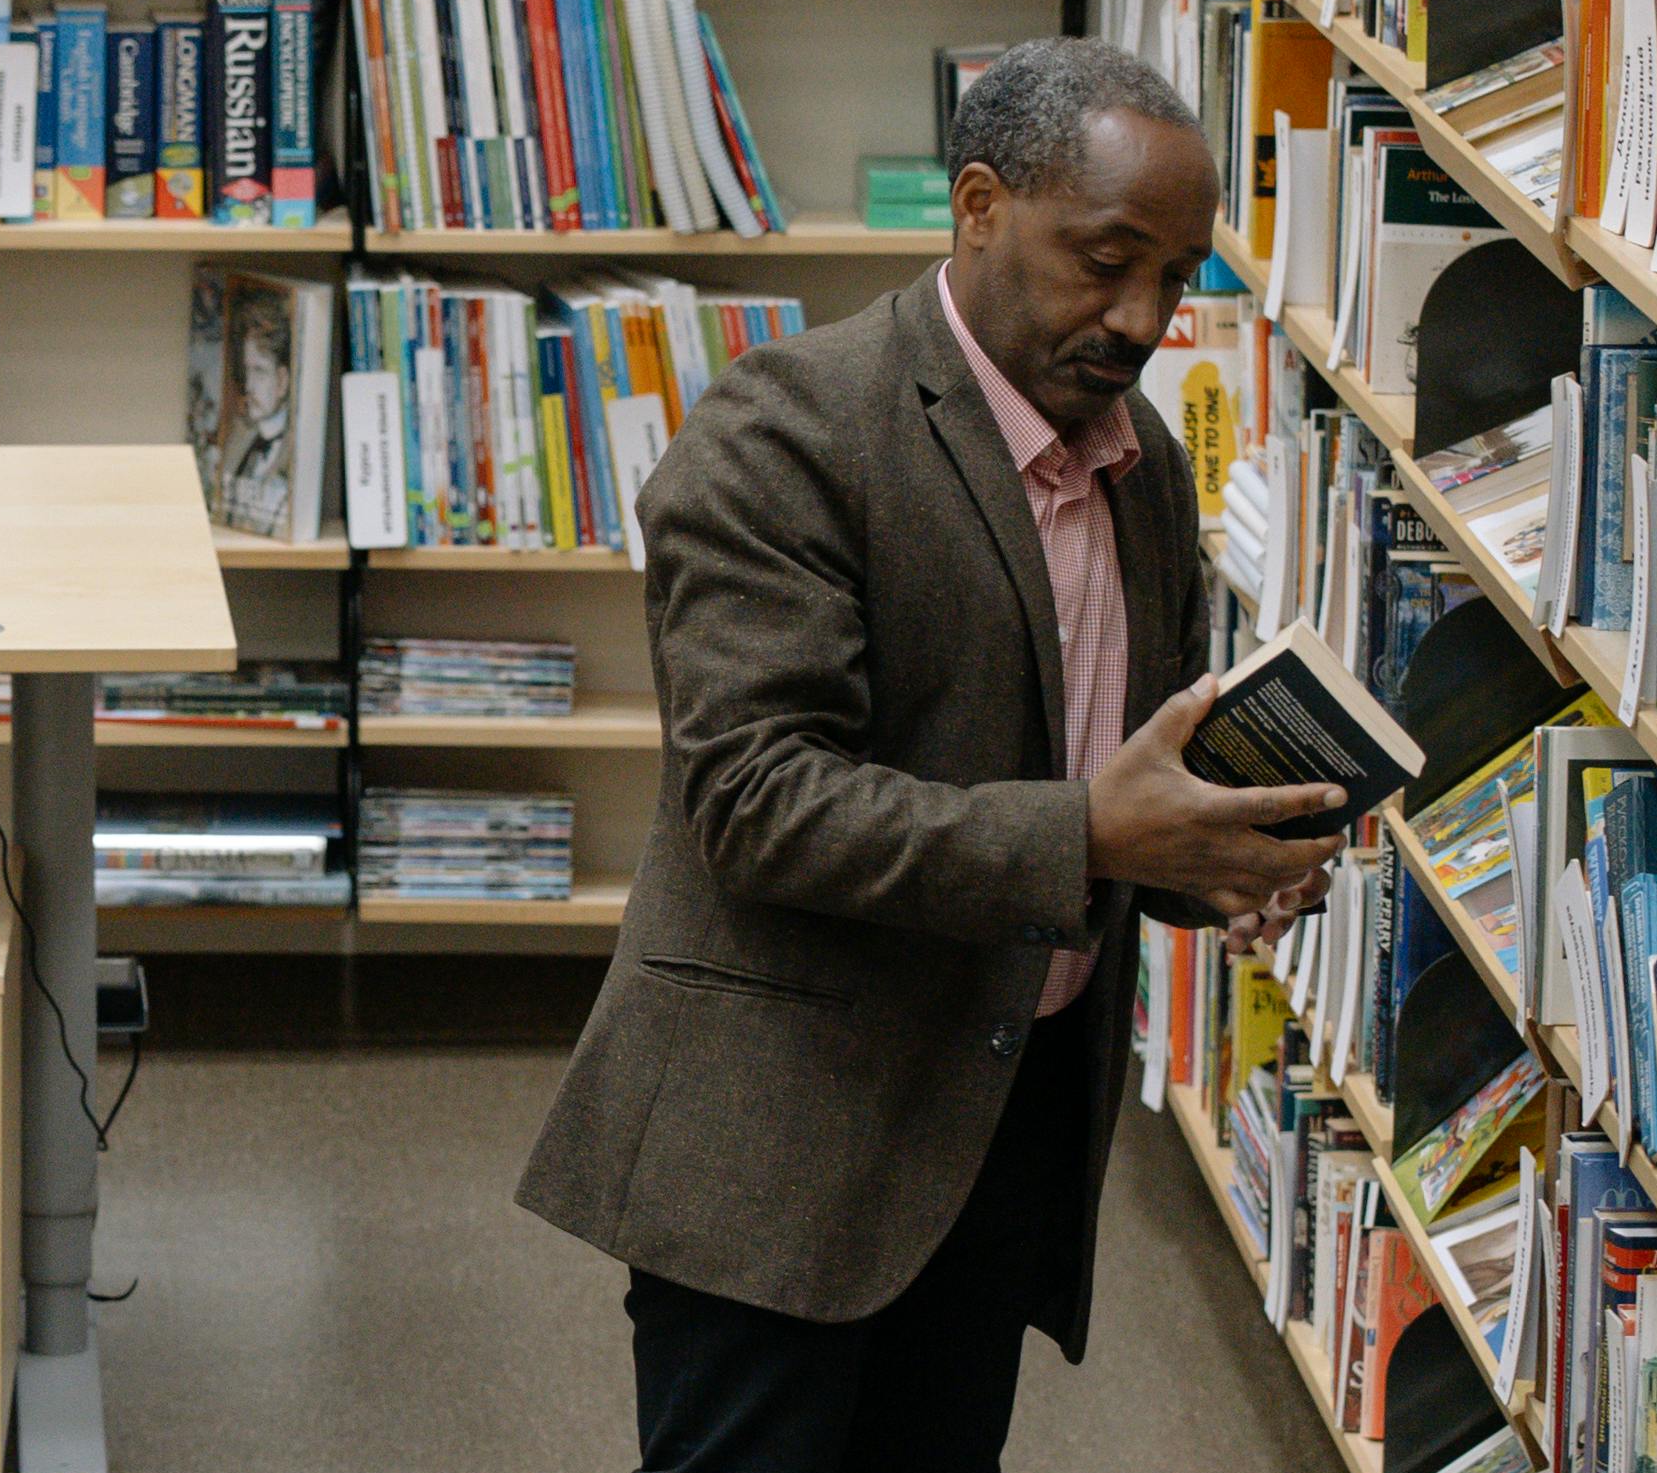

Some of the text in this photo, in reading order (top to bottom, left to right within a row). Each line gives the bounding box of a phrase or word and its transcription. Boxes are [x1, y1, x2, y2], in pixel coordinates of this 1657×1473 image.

[115, 38, 140, 136] Cambridge
[177, 29, 201, 142] LONGMAN
[224, 16, 268, 178] Russian
[1428, 190, 1449, 203] The
[1204, 385, 1220, 495] ONE TO ONE
[1380, 839, 1394, 953] ANNE PERRY
